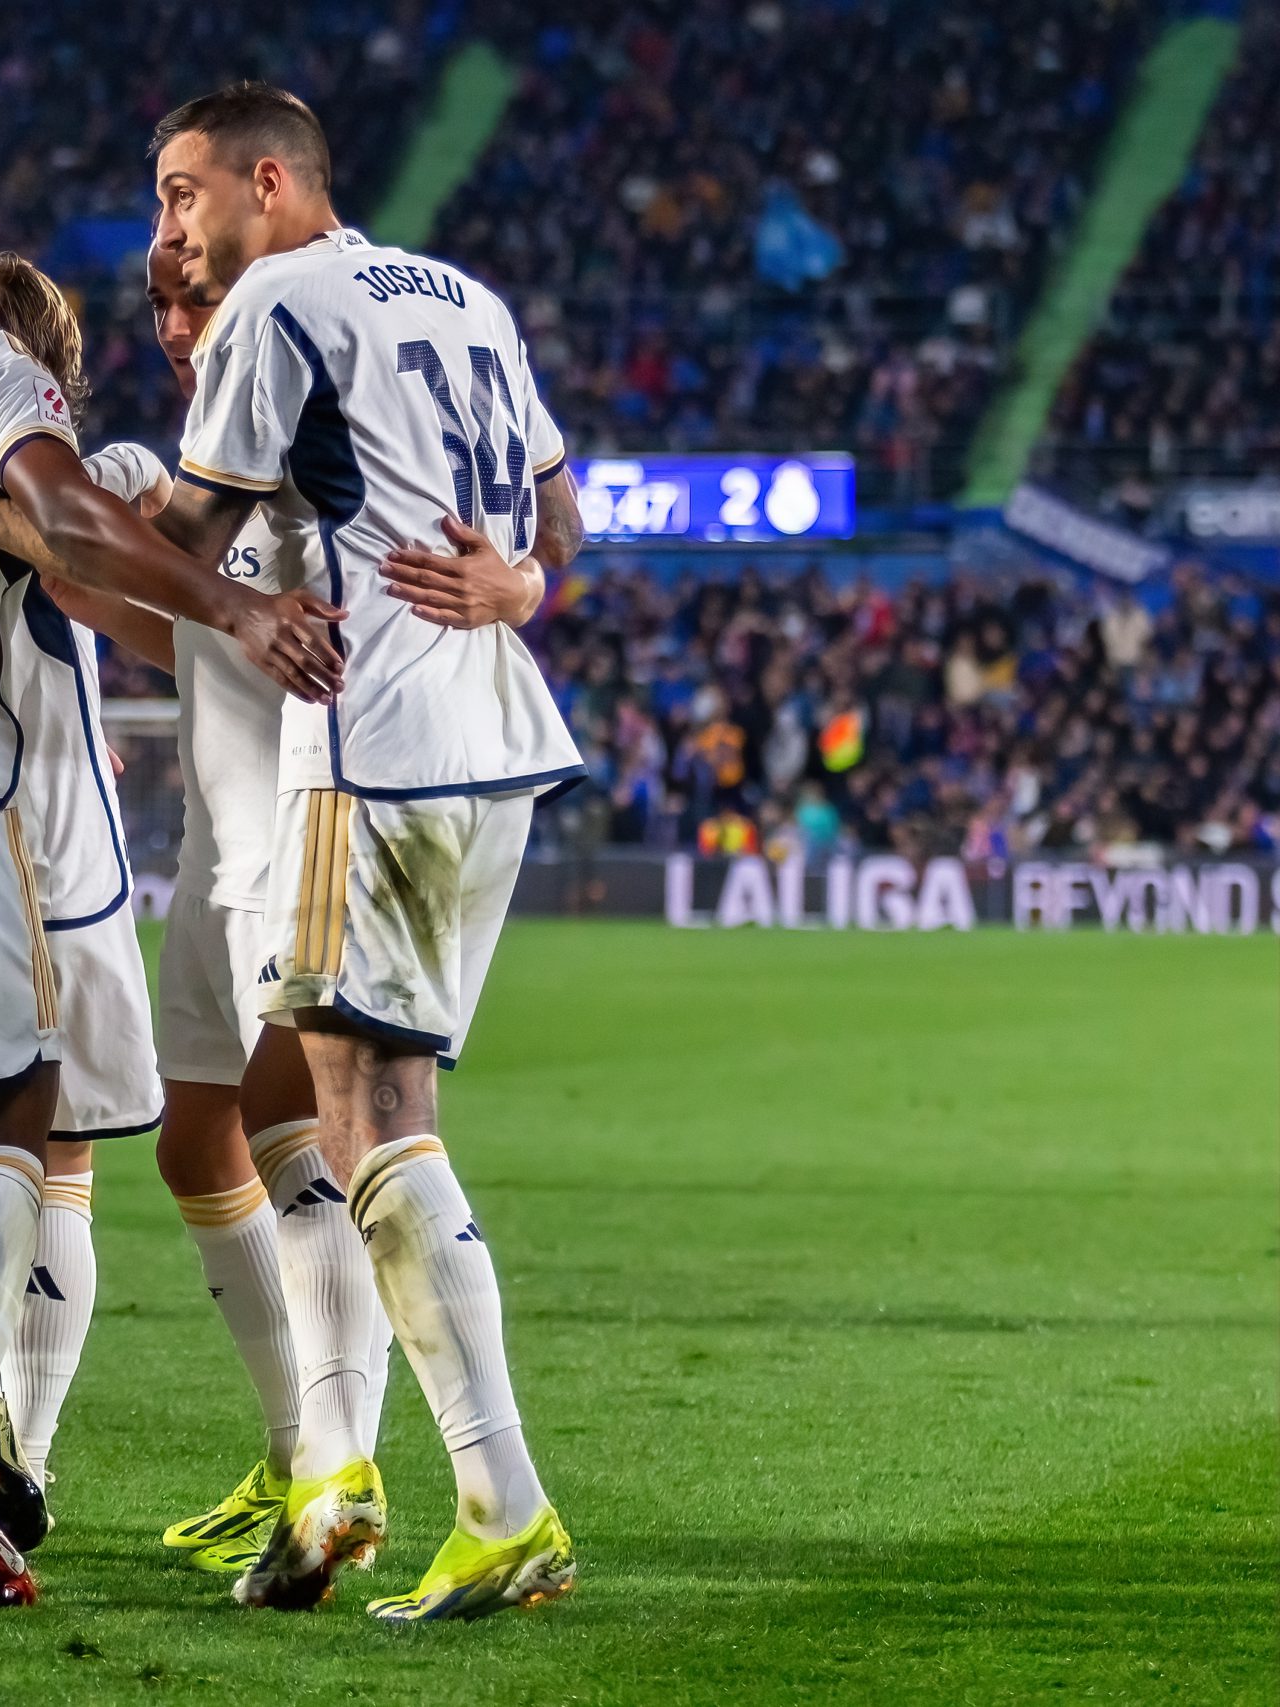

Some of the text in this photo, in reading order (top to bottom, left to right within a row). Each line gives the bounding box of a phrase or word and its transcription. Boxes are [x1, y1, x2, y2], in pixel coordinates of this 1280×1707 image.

[353, 264, 466, 309] JOSELU
[397, 339, 534, 551] 14
[720, 467, 760, 525] 2
[666, 853, 976, 931] LALIGA
[1015, 863, 1259, 935] BEYOND
